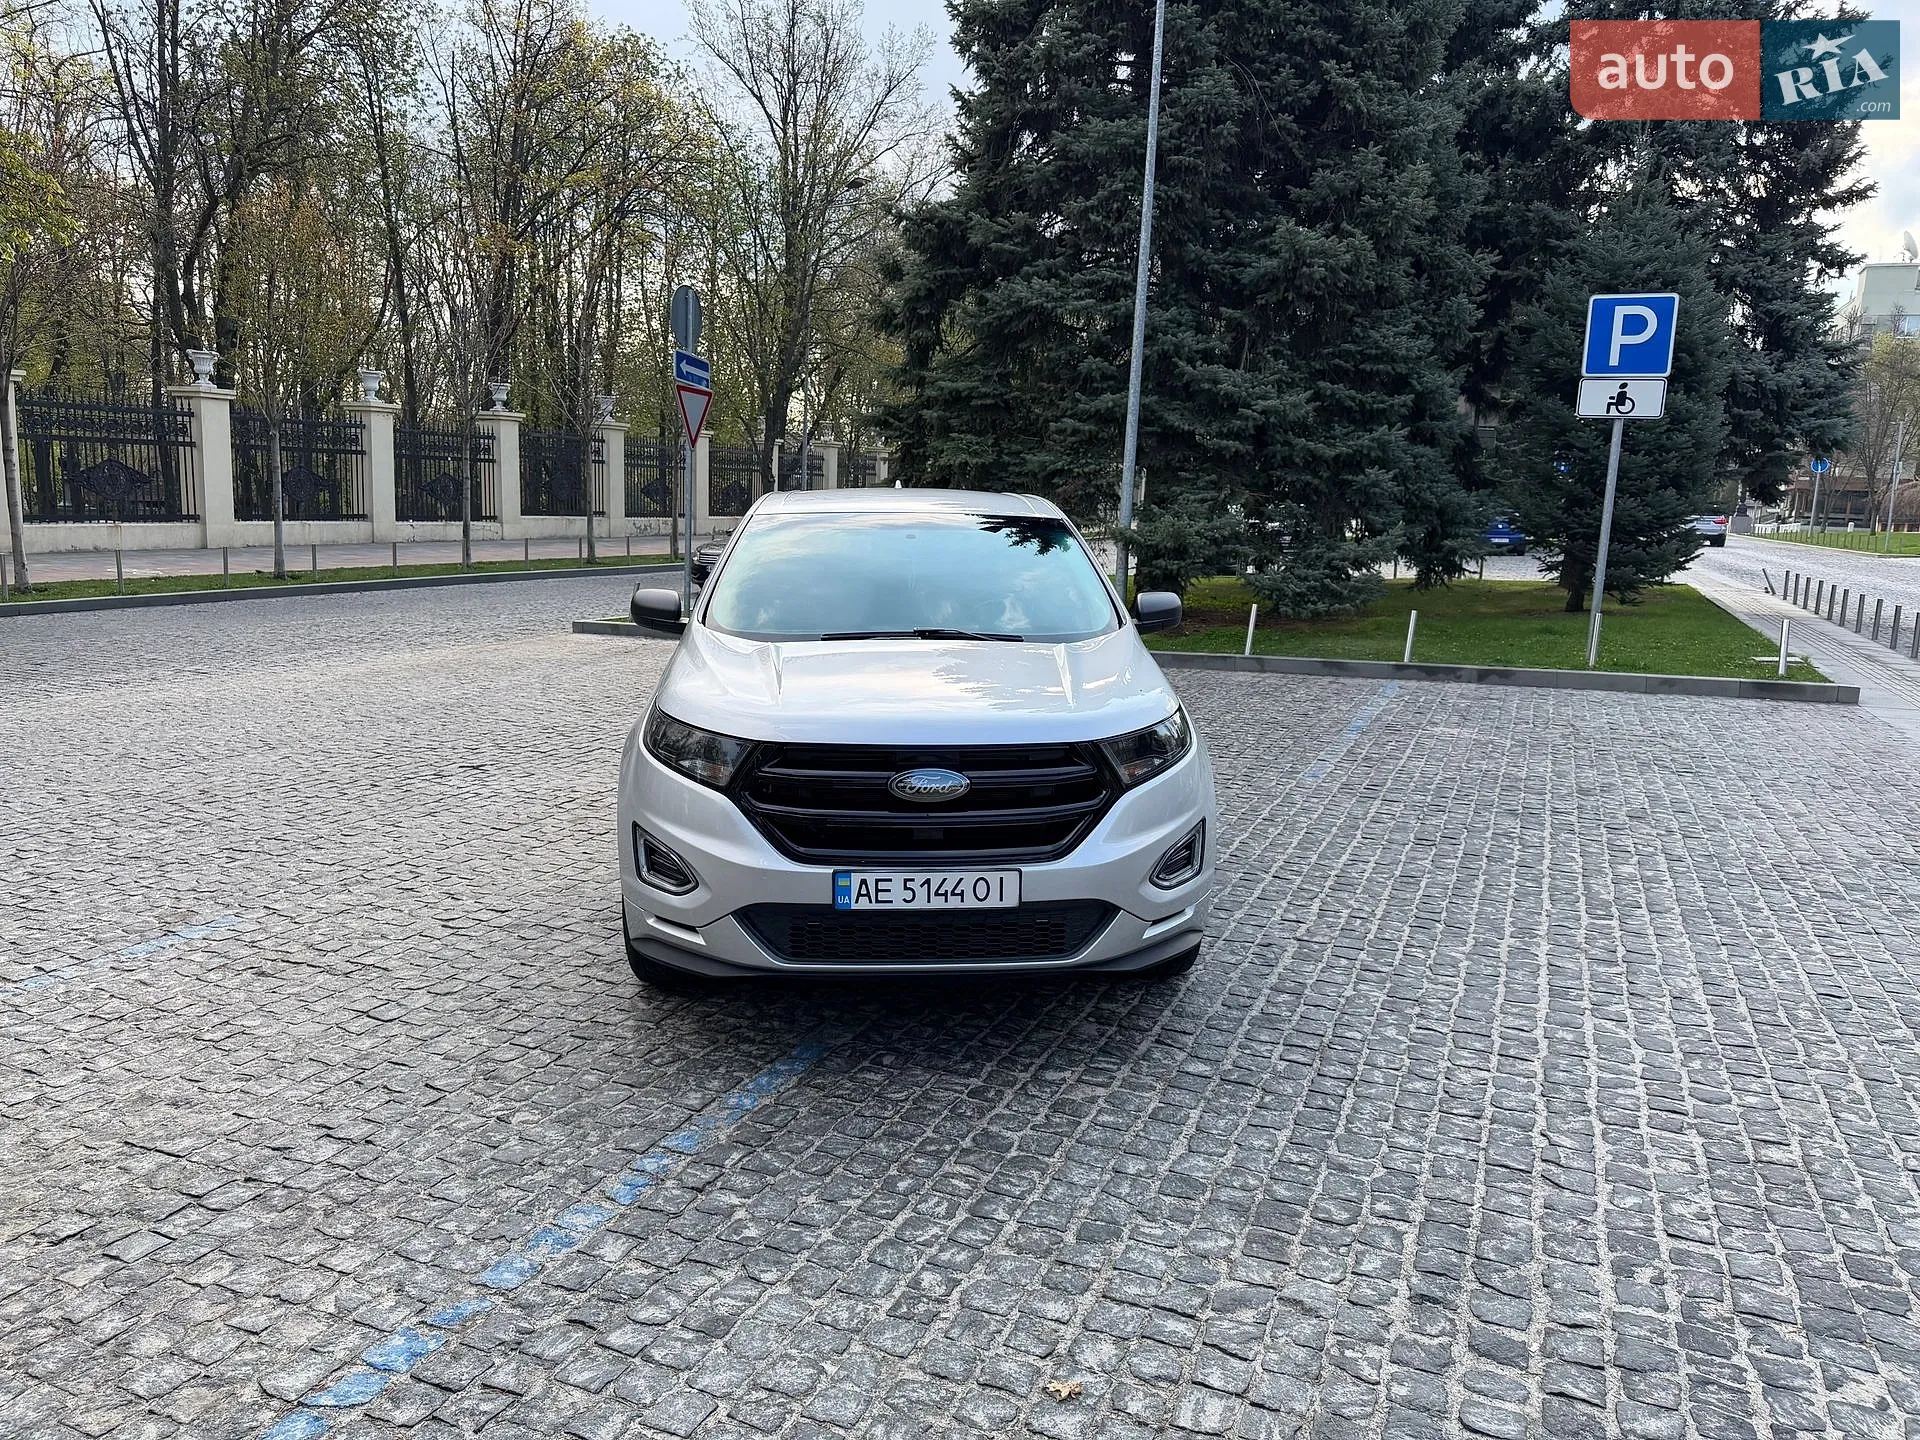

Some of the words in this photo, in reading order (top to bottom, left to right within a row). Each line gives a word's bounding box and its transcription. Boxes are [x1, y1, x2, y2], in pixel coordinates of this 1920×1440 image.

[1608, 305, 1658, 366] P
[904, 775, 953, 794] Ford
[838, 895, 850, 904] UA
[854, 878, 894, 904] AE
[902, 877, 965, 904] 5144
